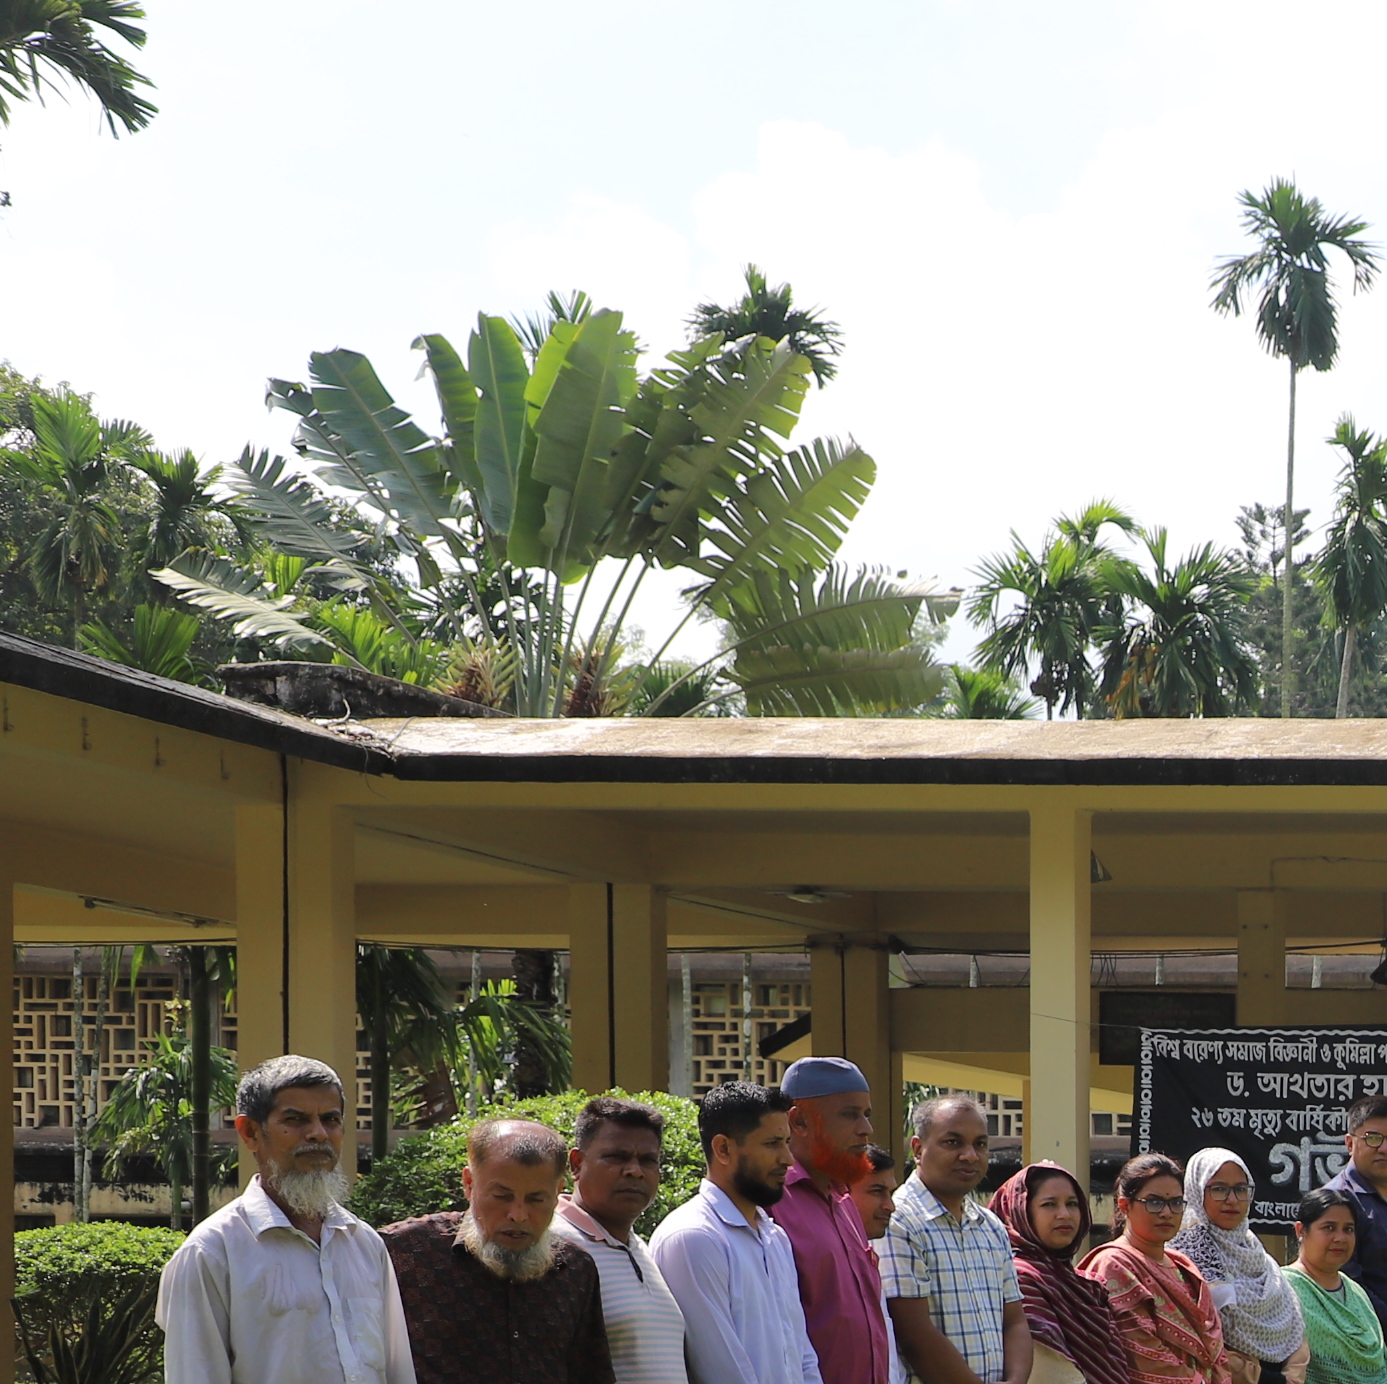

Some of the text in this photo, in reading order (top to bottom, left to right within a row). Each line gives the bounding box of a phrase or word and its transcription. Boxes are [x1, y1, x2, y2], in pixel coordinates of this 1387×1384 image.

[1151, 1035, 1181, 1060] বিশ্ব
[1183, 1040, 1224, 1064] বরেণ্য
[1226, 1041, 1266, 1064] সমাজ
[1268, 1037, 1317, 1063] বিজ্ঞানী
[1320, 1044, 1332, 1062] ও
[1333, 1038, 1376, 1070] কুমিল্লা
[1226, 1072, 1250, 1097] ড.
[1256, 1071, 1357, 1101] আখতার
[1191, 1107, 1213, 1128] ২৬
[1217, 1107, 1246, 1129] তম
[1248, 1109, 1284, 1140] মৃত্যু
